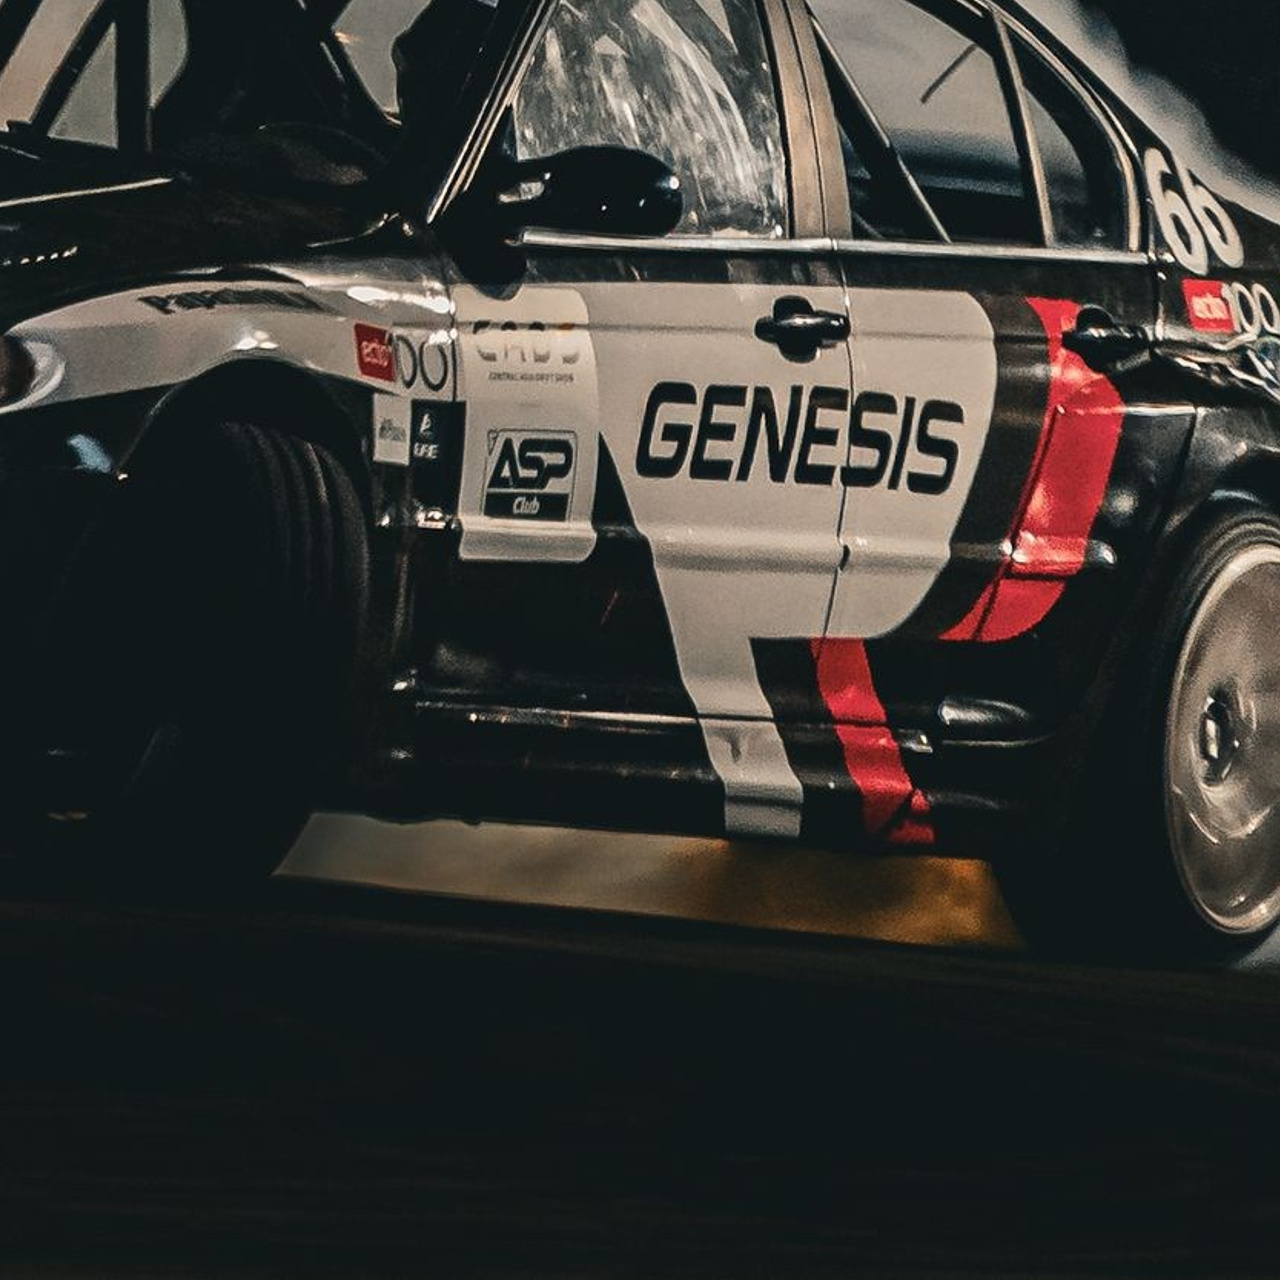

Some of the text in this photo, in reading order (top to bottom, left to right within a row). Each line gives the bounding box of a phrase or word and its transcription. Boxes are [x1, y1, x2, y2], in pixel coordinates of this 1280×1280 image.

[1144, 147, 1245, 276] 66
[488, 437, 573, 490] ASP
[635, 380, 965, 496] GENESIS
[513, 499, 540, 515] Club
